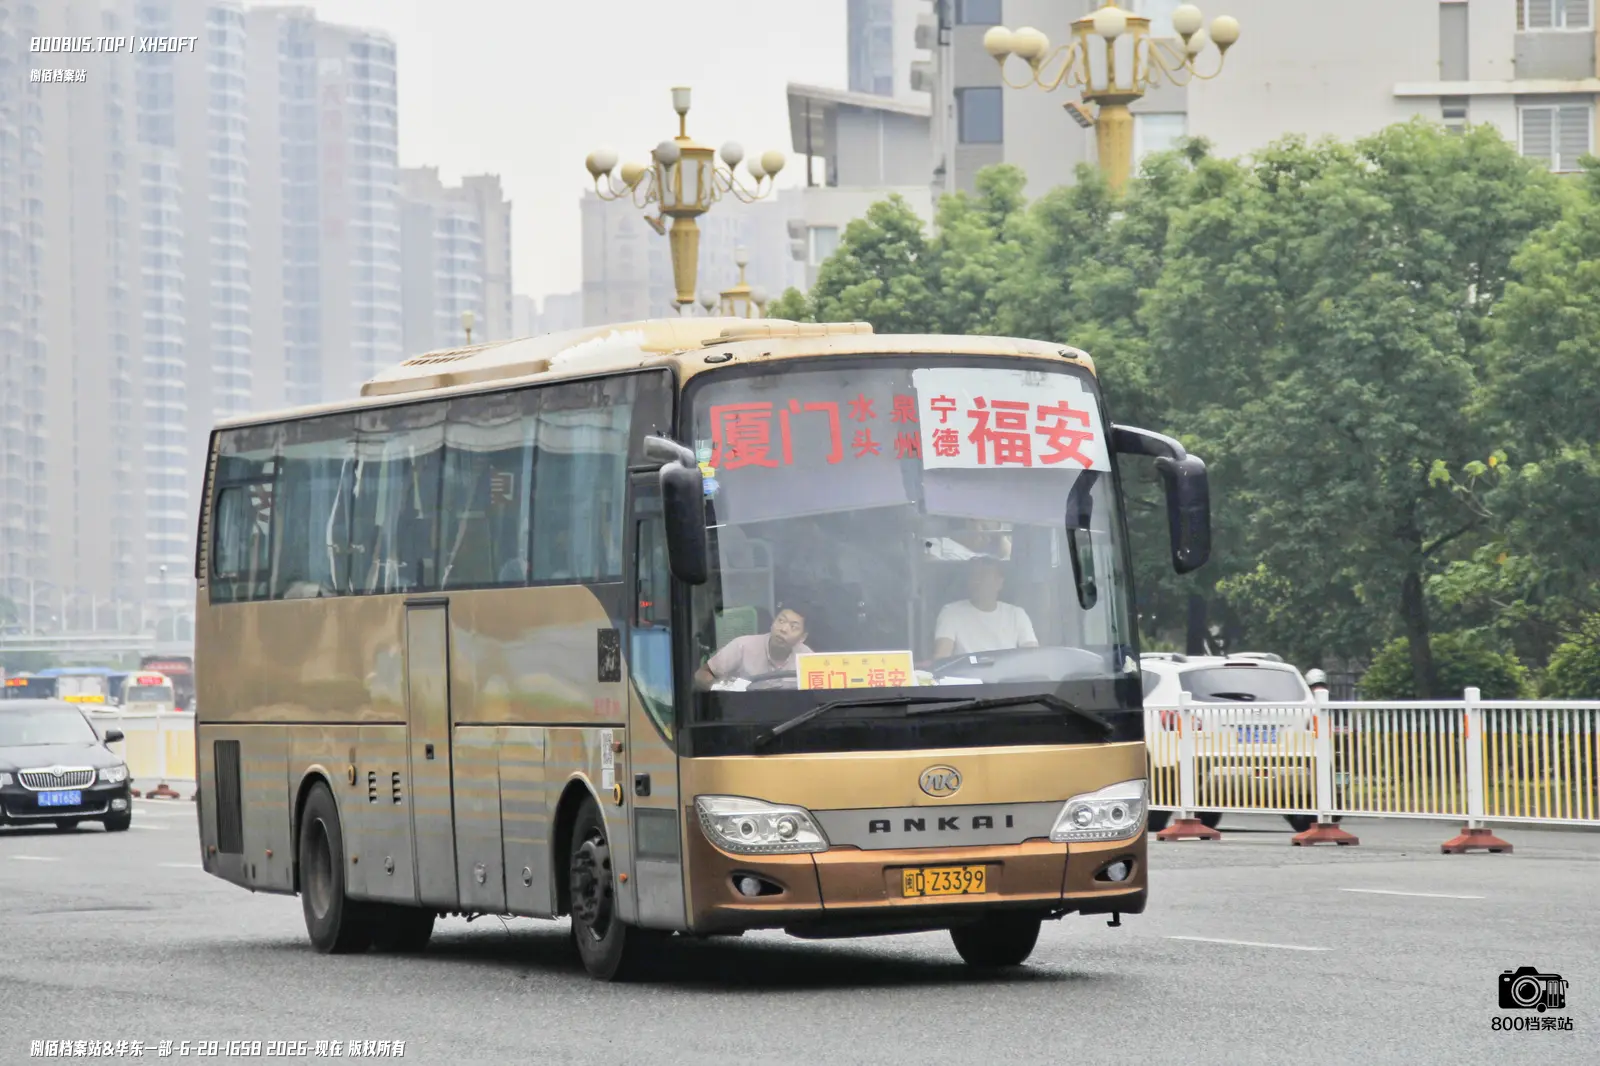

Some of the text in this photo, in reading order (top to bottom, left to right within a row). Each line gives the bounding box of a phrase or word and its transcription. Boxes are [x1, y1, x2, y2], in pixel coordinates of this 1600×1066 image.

[708, 399, 844, 471] 厦门
[848, 393, 881, 459] 水头
[889, 394, 922, 460] 泉州
[930, 394, 960, 458] 宁德
[967, 395, 1095, 470] 福安
[868, 814, 1014, 834] ANKAI
